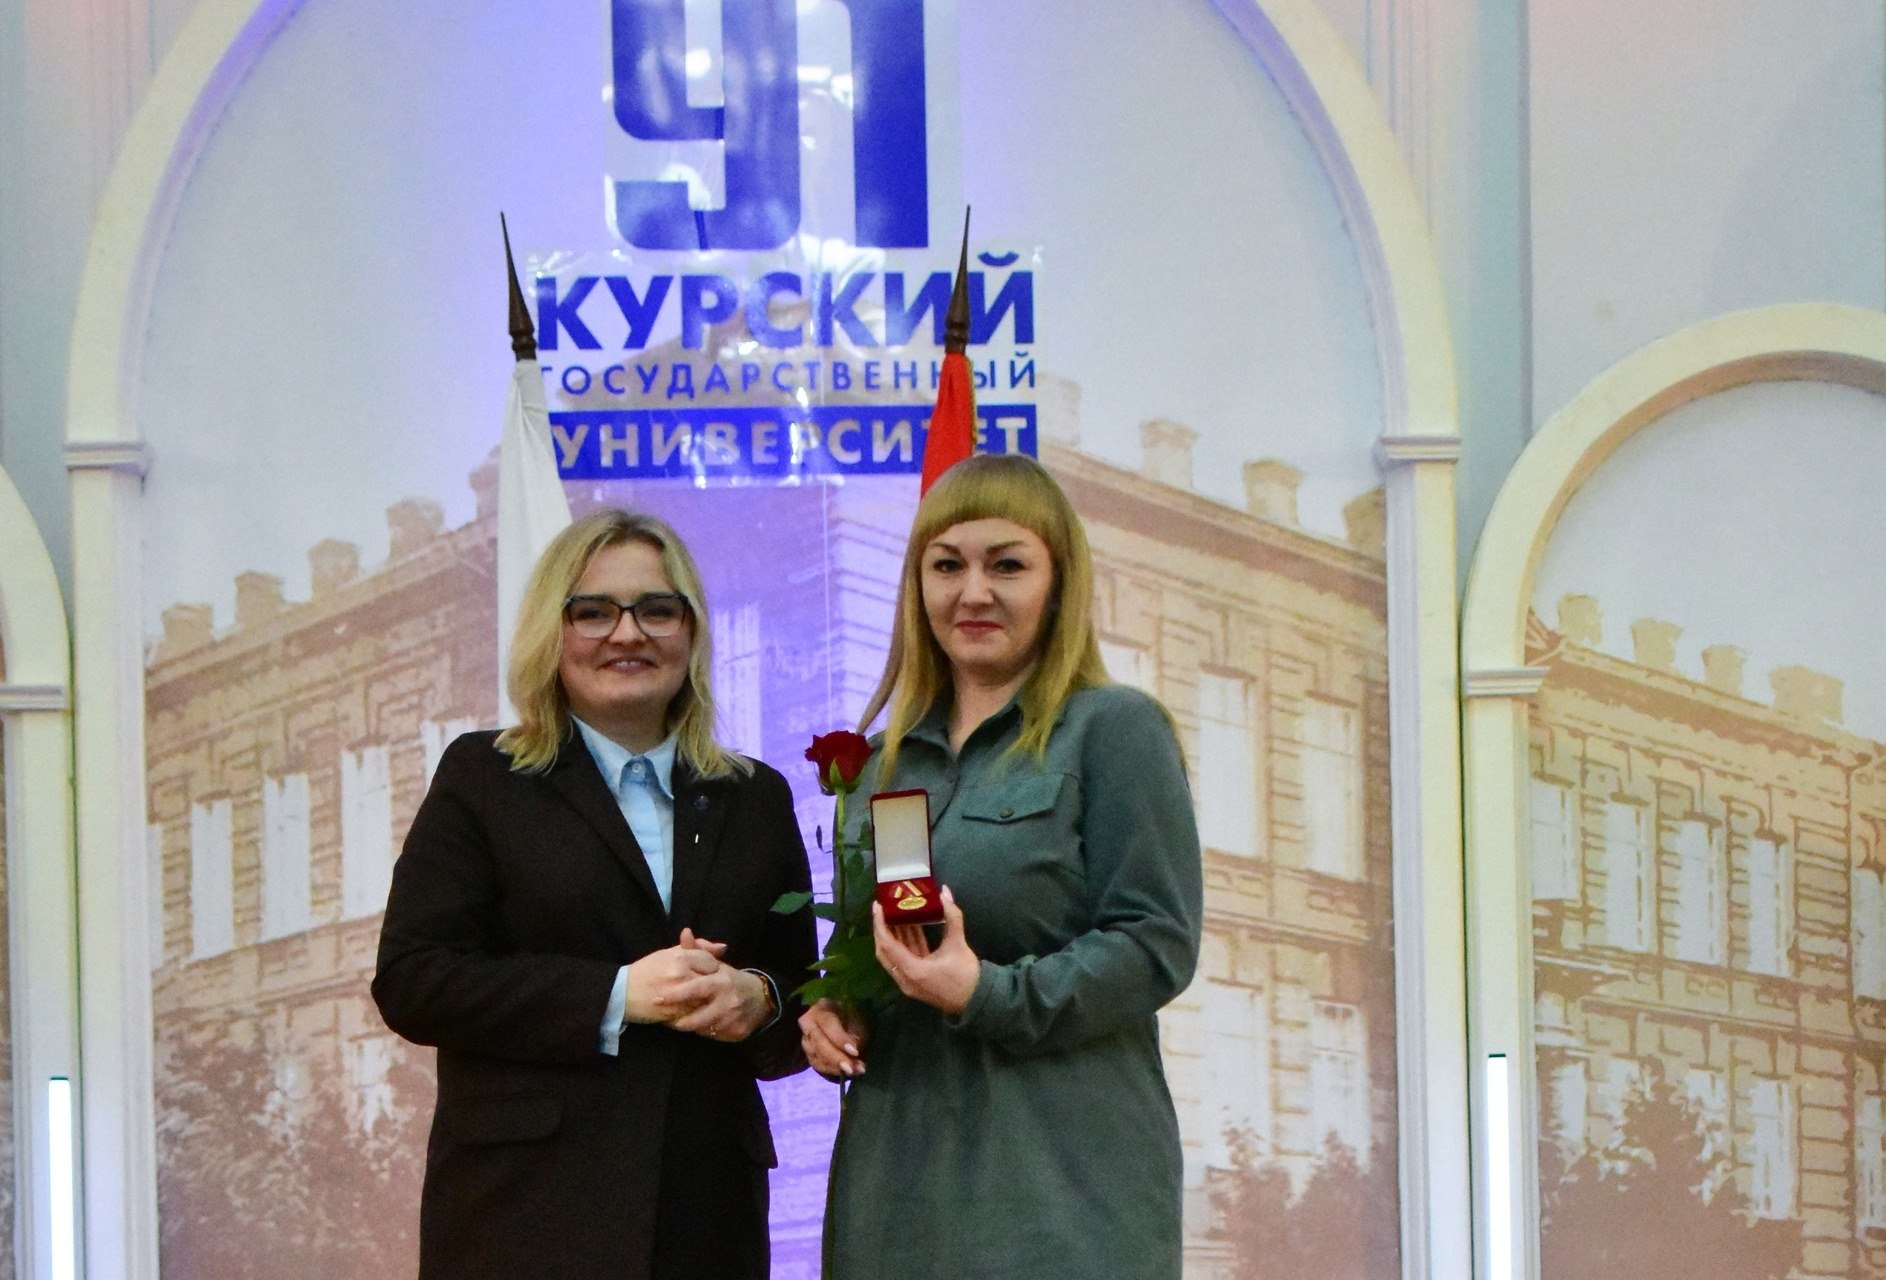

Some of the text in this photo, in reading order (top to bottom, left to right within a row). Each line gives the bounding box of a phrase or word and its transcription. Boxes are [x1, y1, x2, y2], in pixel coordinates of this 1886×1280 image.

[536, 250, 1034, 351] КУРСКИЙ
[540, 351, 1035, 400] ОСУДАРСТВЕНЫЙ
[551, 416, 1028, 469] УНИВЕРСИТ
